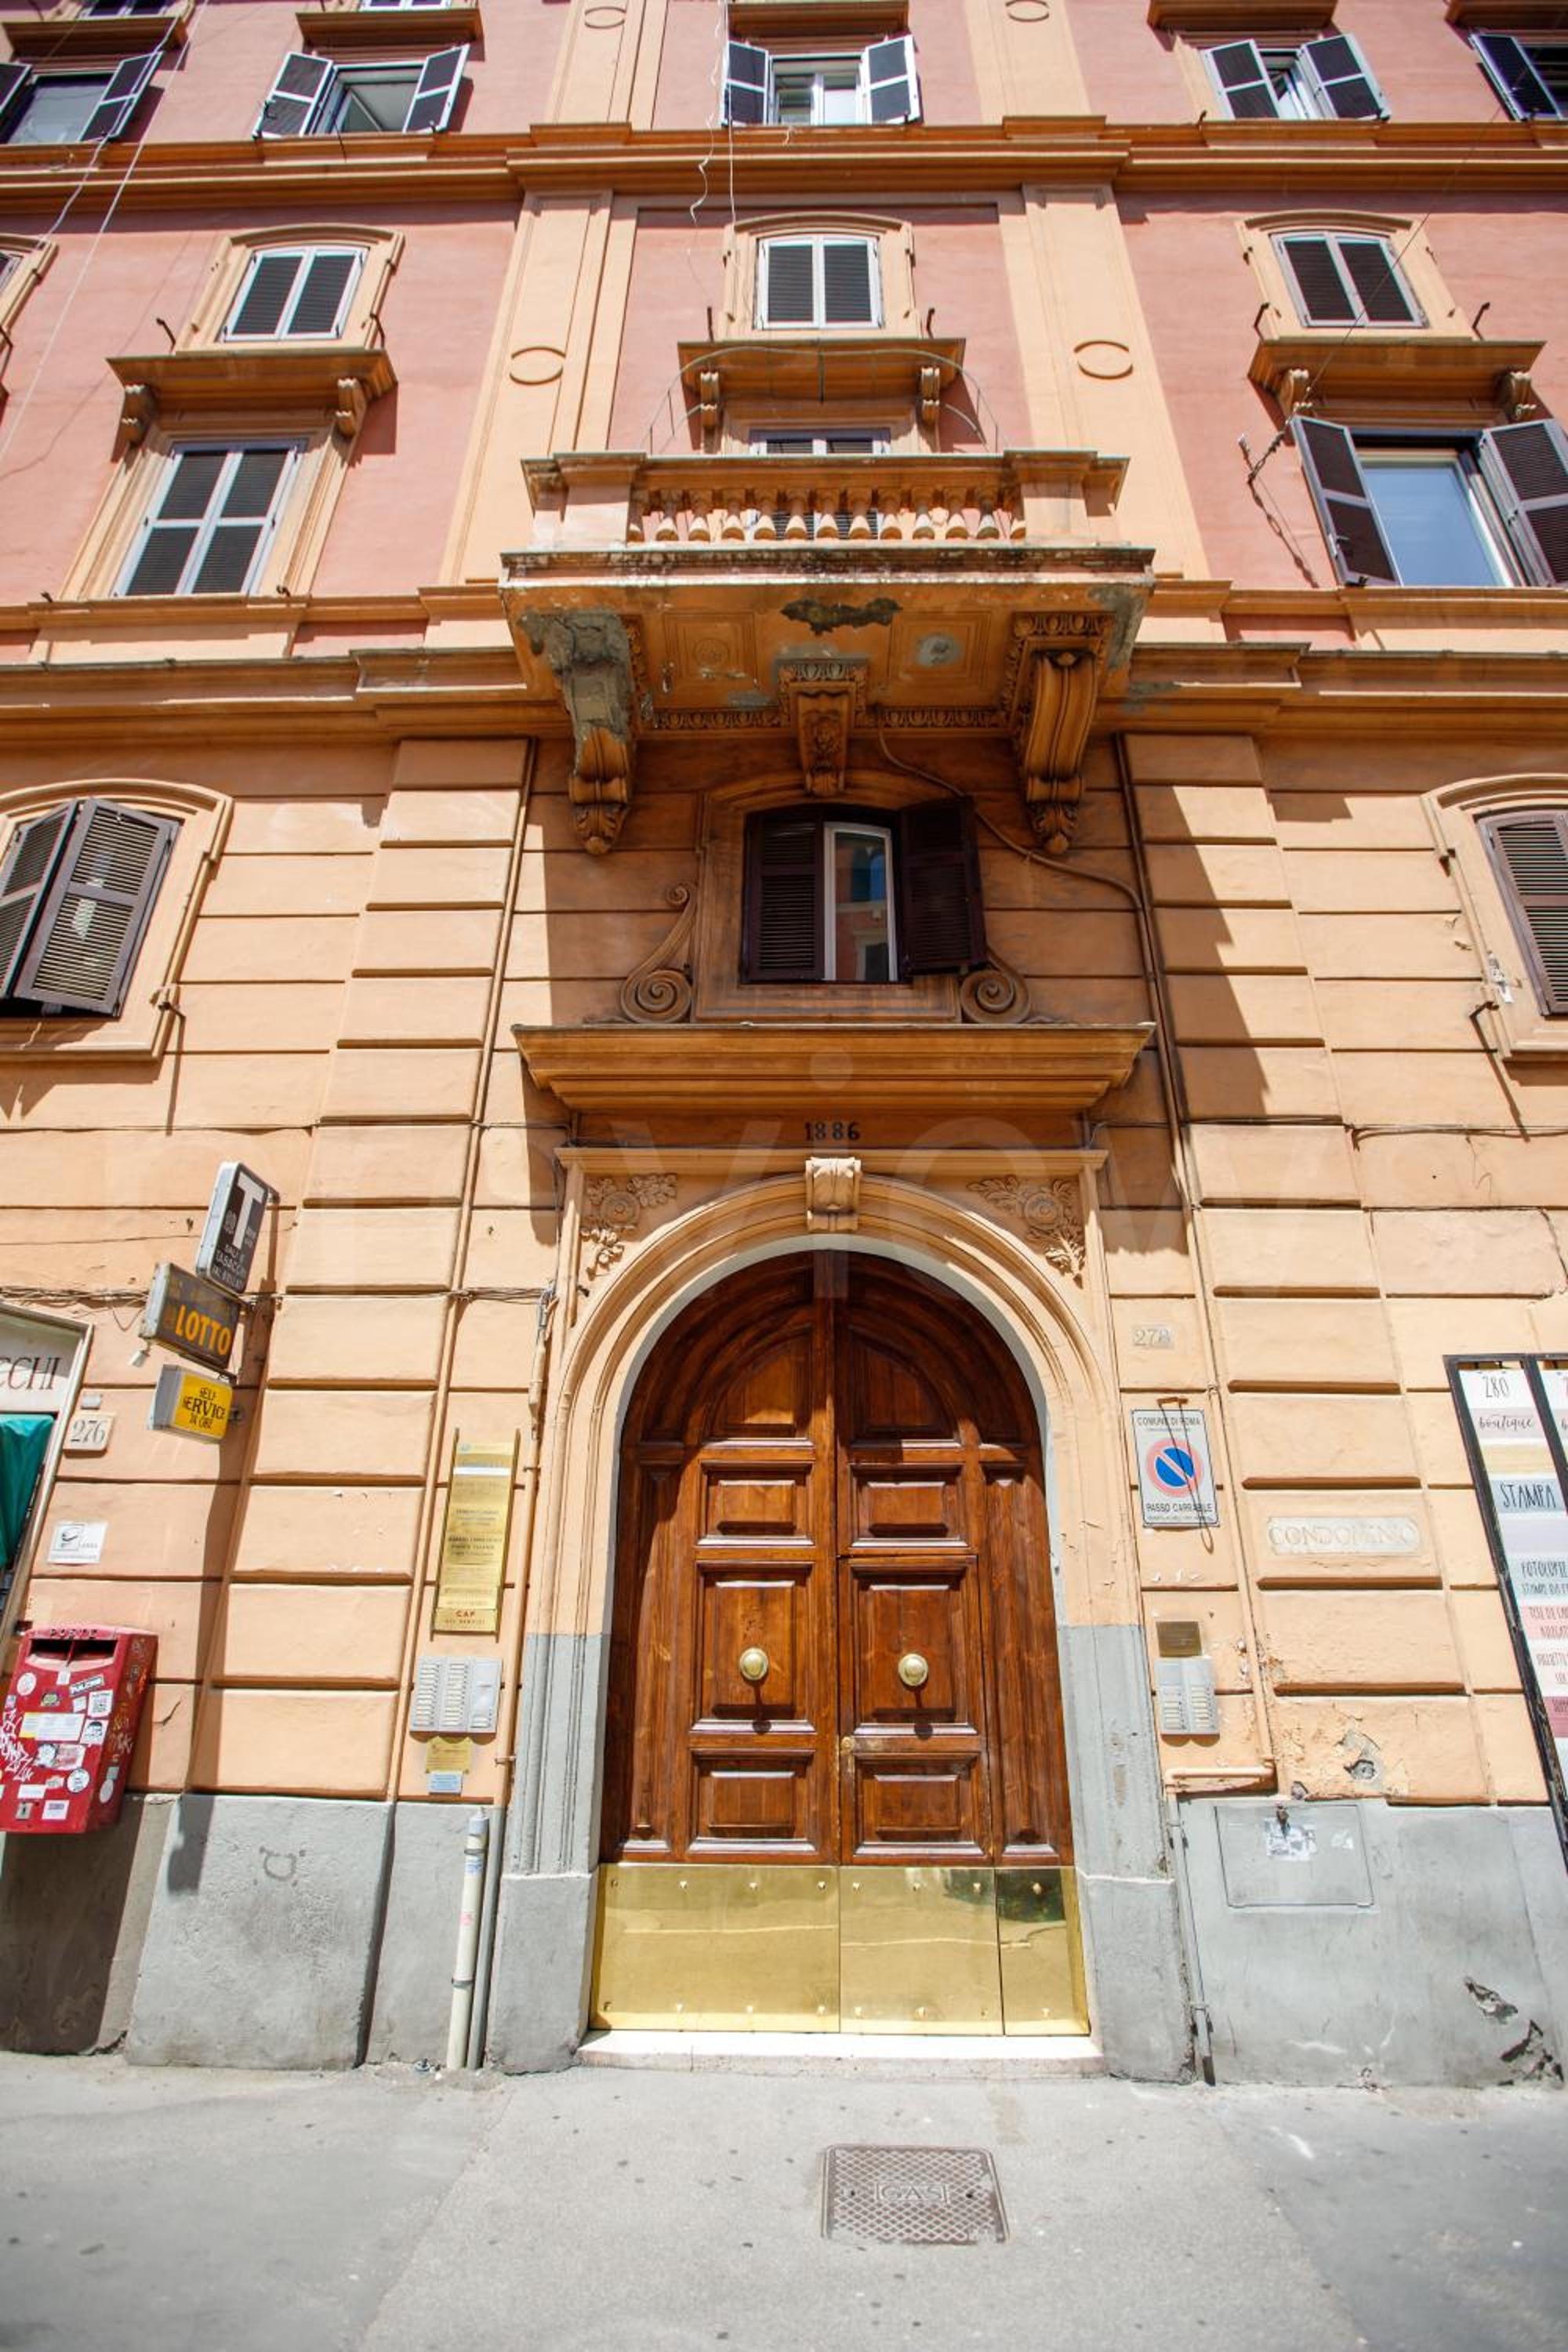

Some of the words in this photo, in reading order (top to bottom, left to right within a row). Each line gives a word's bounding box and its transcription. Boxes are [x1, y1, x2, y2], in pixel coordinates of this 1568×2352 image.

[805, 1120, 860, 1142] 1886
[231, 1171, 265, 1250] T
[175, 1304, 231, 1356] LOTTO
[199, 1387, 217, 1402] SELF
[1483, 1375, 1510, 1398] 280
[183, 1396, 226, 1420] SERVICE
[71, 1418, 106, 1444] 276
[1137, 1417, 1168, 1426] COMUNE
[1170, 1417, 1178, 1425] DI
[1479, 1414, 1533, 1431] boutique
[1500, 1483, 1556, 1509] STAMPA
[1146, 1503, 1171, 1513] PASSO
[1172, 1503, 1213, 1513] CARRABILE
[880, 2184, 944, 2202] GAS
